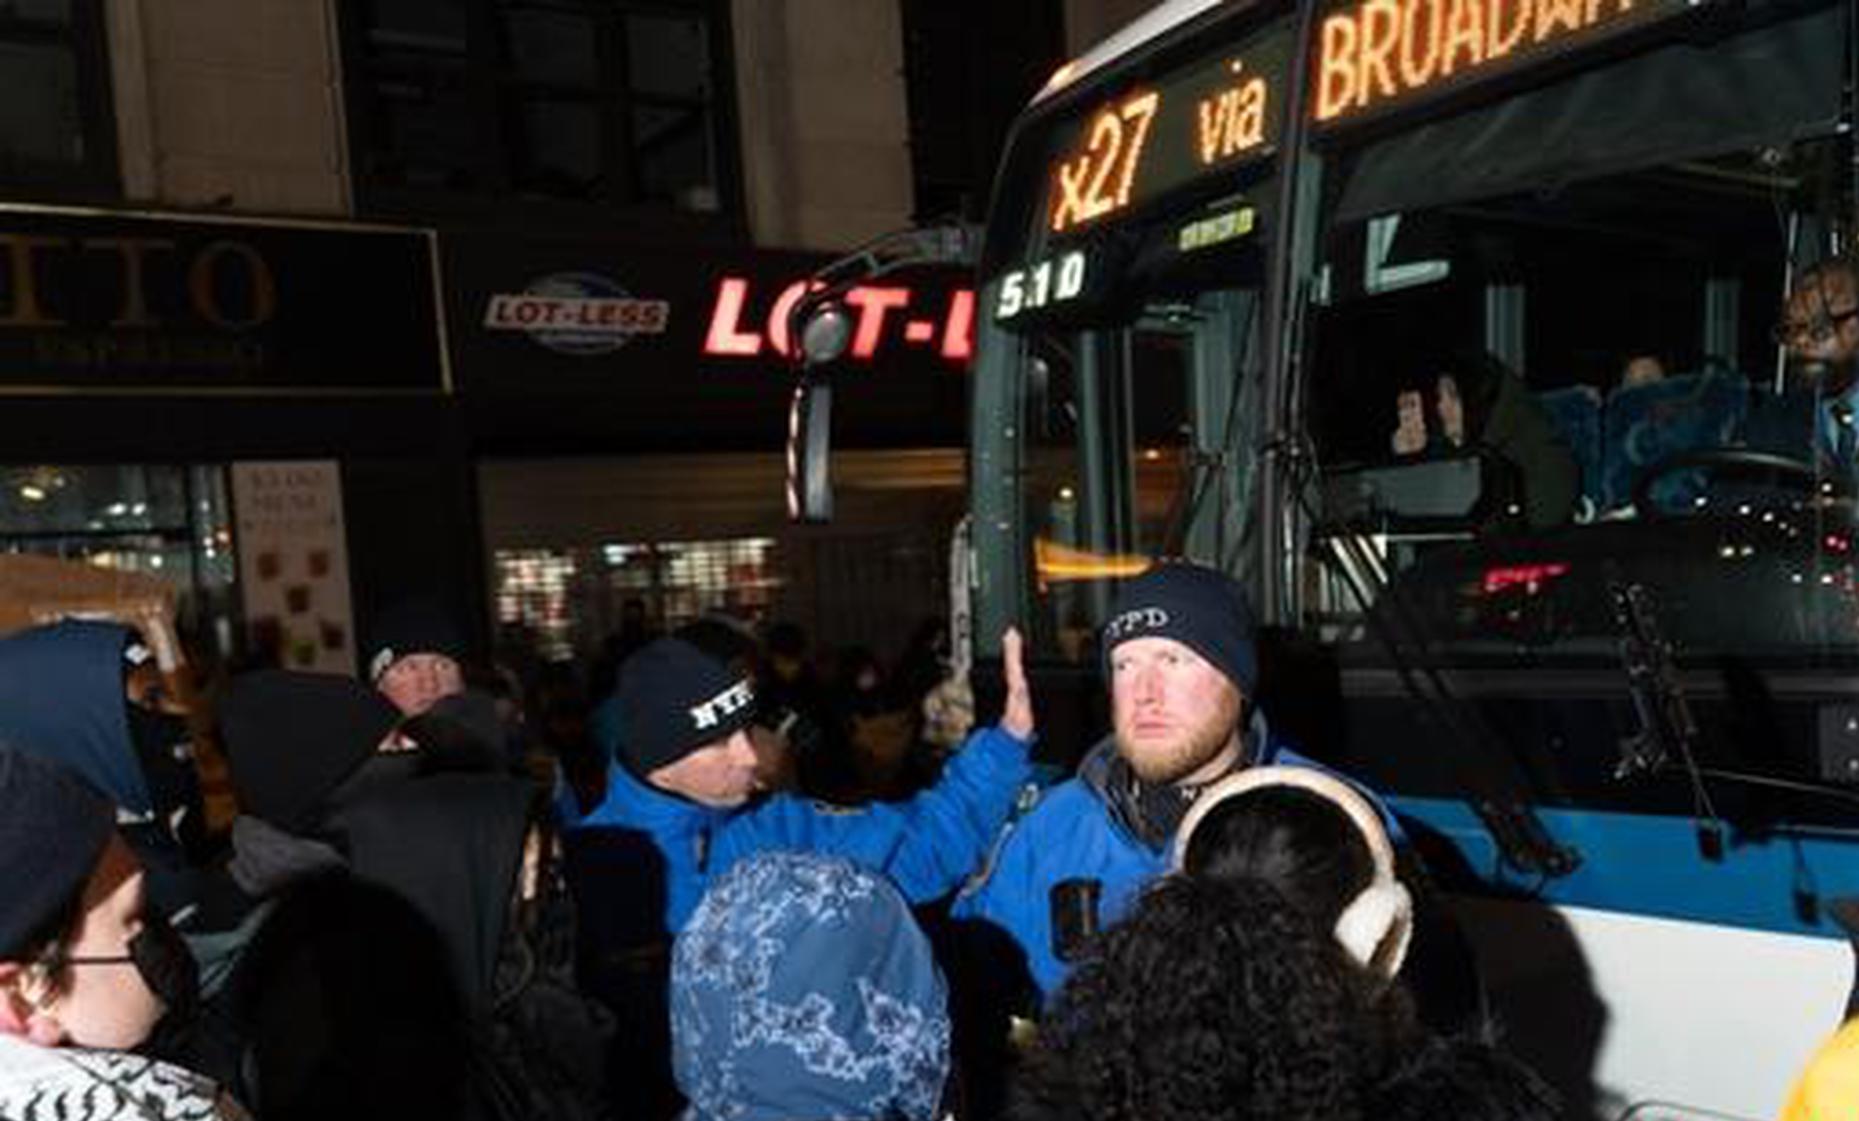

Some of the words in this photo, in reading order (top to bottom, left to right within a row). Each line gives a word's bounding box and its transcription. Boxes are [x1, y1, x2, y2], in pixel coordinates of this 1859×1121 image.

[1315, 0, 1633, 121] BROAD
[1052, 91, 1158, 232] x27
[1199, 60, 1267, 165] via
[496, 301, 662, 327] LOT-LESS
